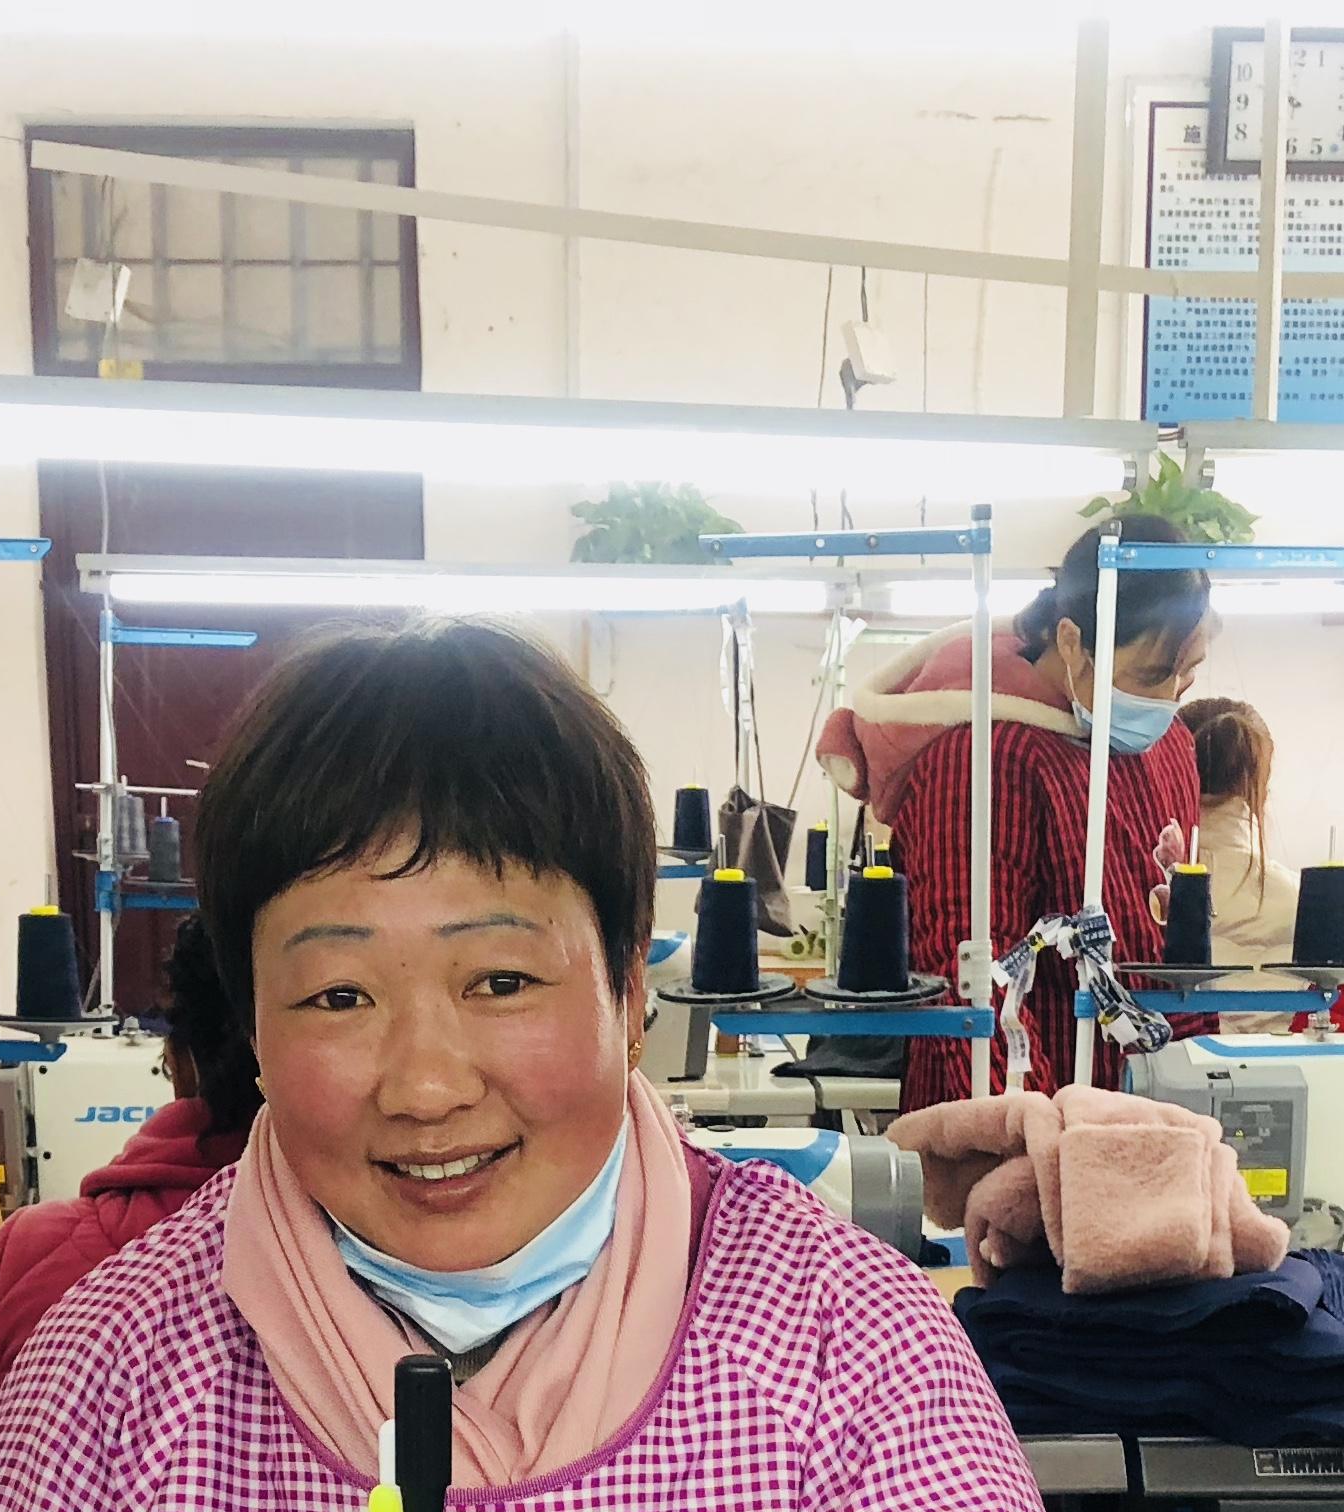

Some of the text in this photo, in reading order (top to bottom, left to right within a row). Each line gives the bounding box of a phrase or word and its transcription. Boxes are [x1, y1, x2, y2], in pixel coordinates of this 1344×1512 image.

[1236, 63, 1253, 82] 10
[1236, 93, 1249, 111] 9
[1234, 122, 1248, 142] 8
[1310, 137, 1323, 156] 5
